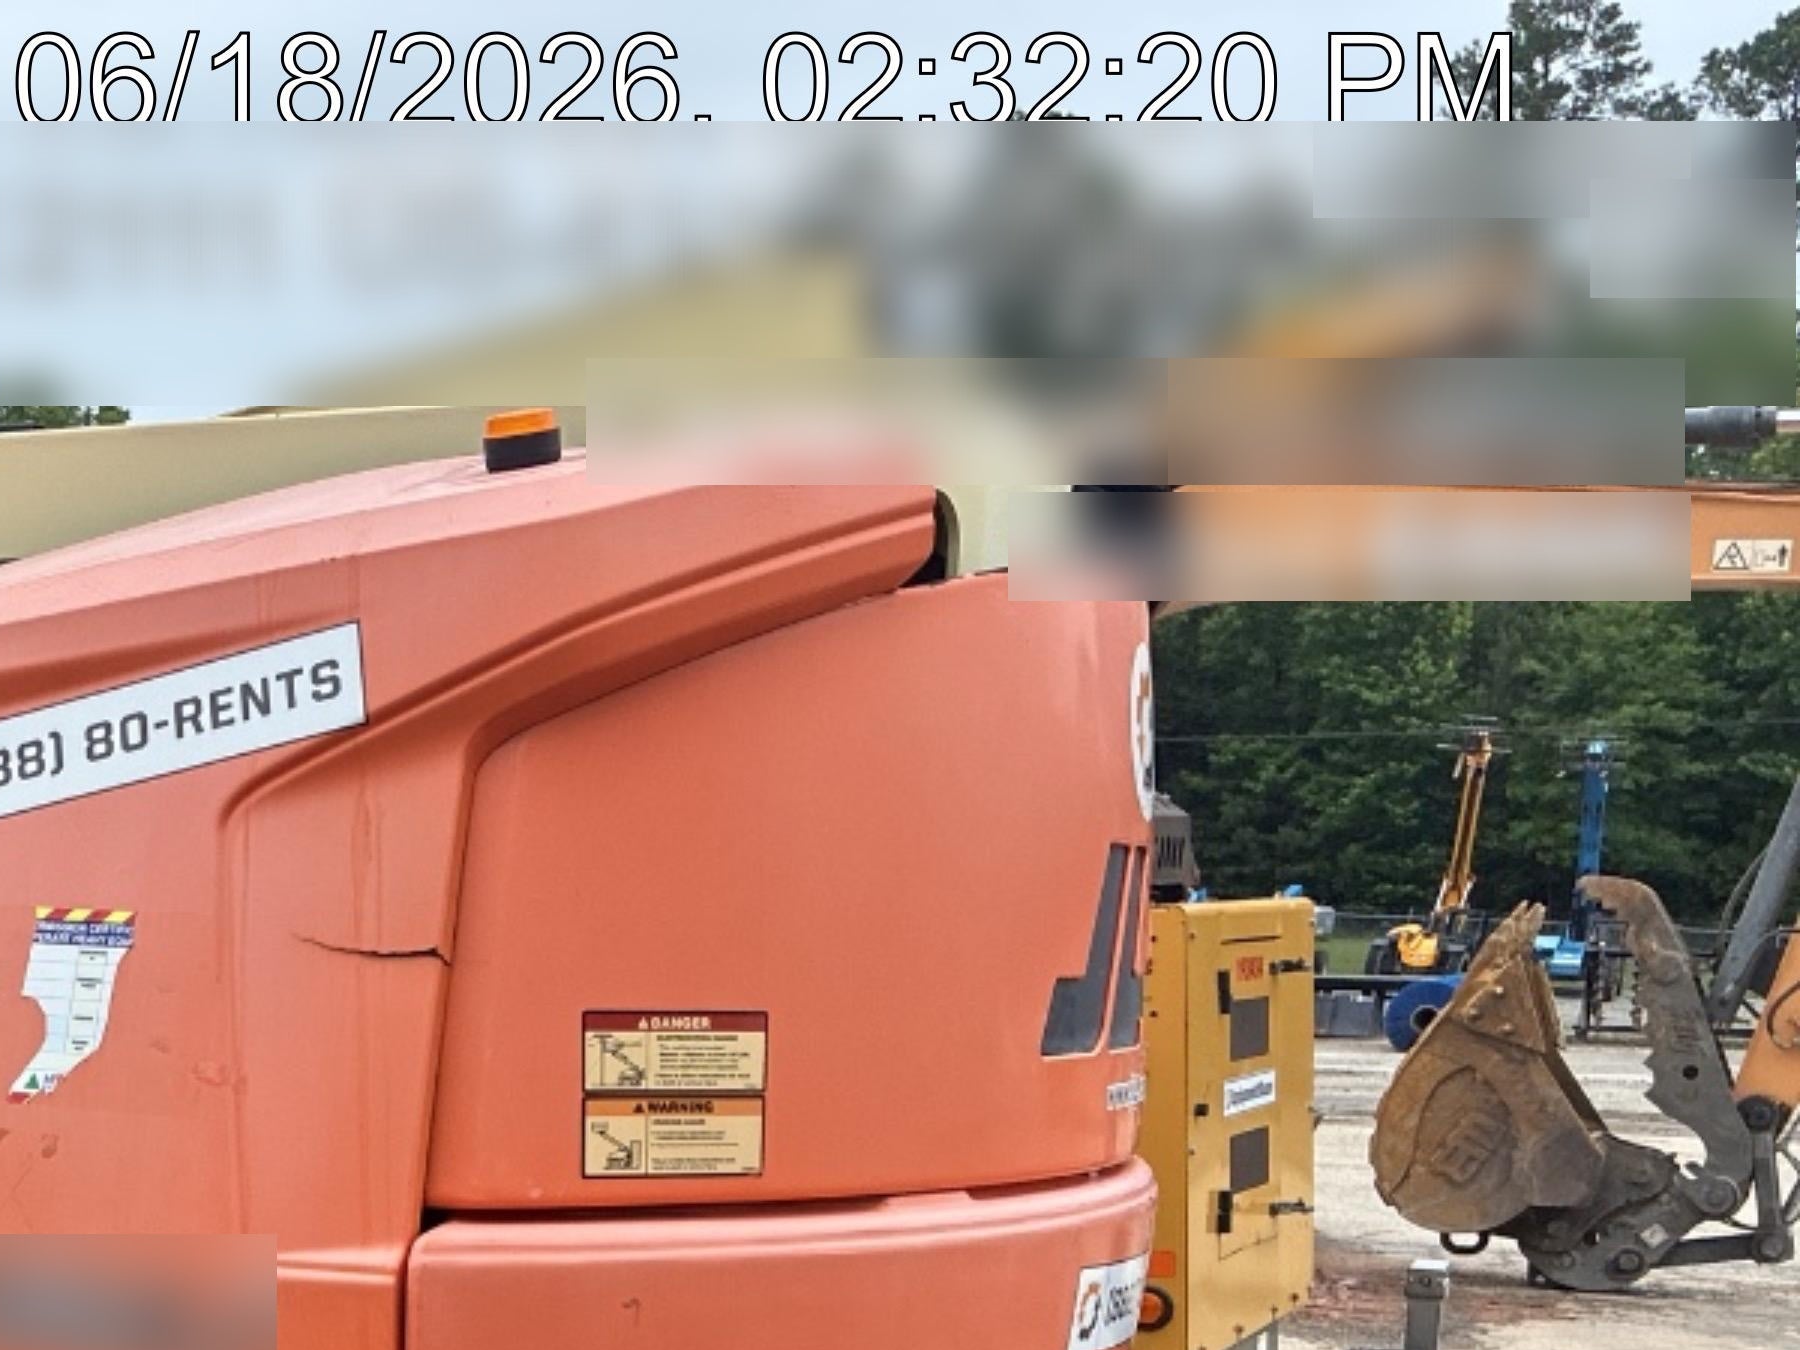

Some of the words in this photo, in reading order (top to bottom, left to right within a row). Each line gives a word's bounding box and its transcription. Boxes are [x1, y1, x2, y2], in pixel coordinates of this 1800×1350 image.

[84, 659, 342, 763] 80-RENTS
[650, 1016, 712, 1029] DANGER
[647, 1101, 715, 1113] WARNING
